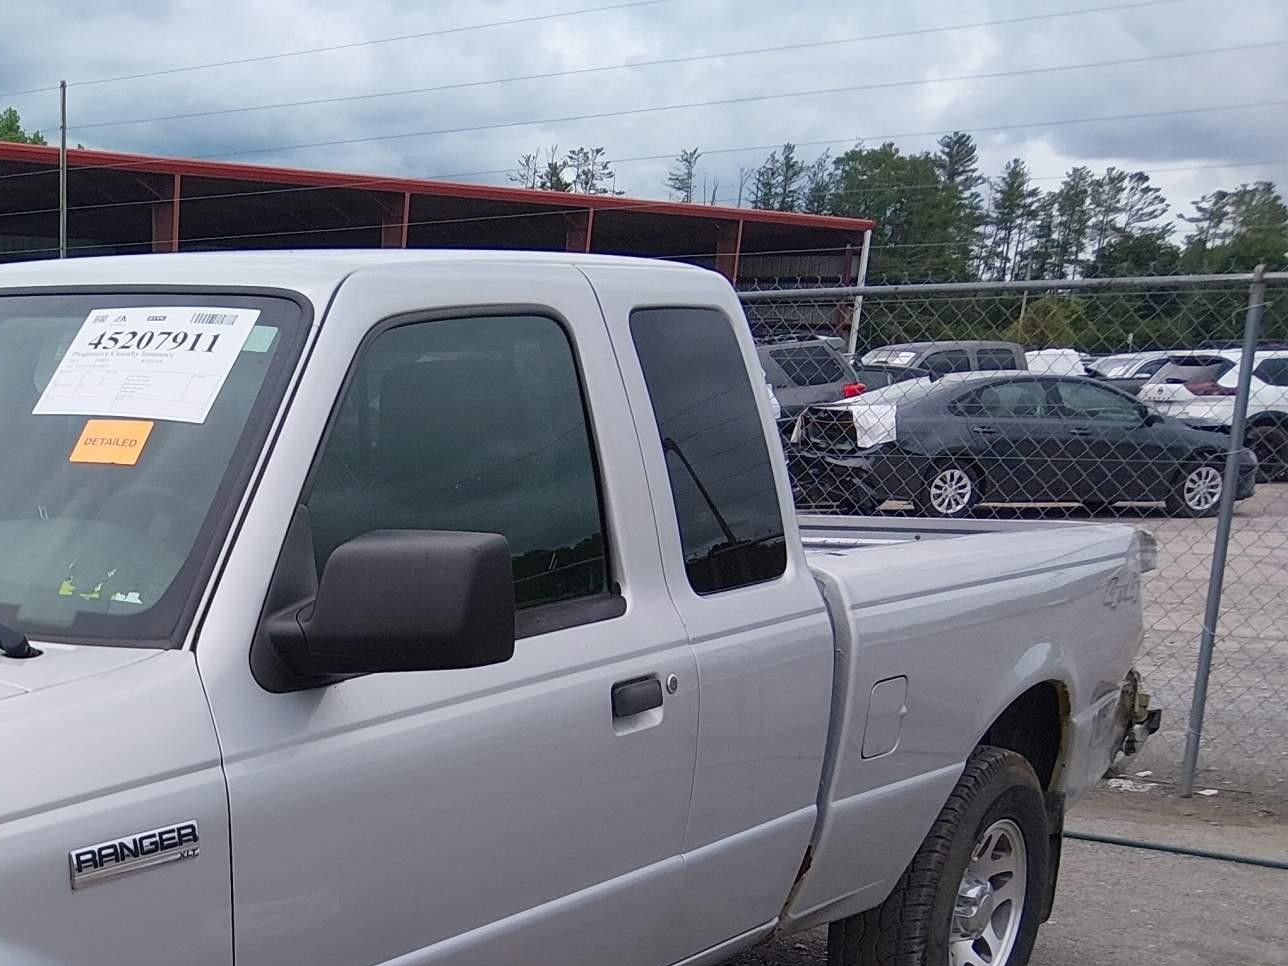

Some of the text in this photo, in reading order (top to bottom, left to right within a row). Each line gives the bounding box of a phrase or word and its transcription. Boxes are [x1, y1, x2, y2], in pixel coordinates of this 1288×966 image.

[87, 330, 222, 353] 45207911
[83, 437, 138, 448] DETAILED
[75, 823, 199, 873] RANGER
[178, 848, 199, 860] XLT
